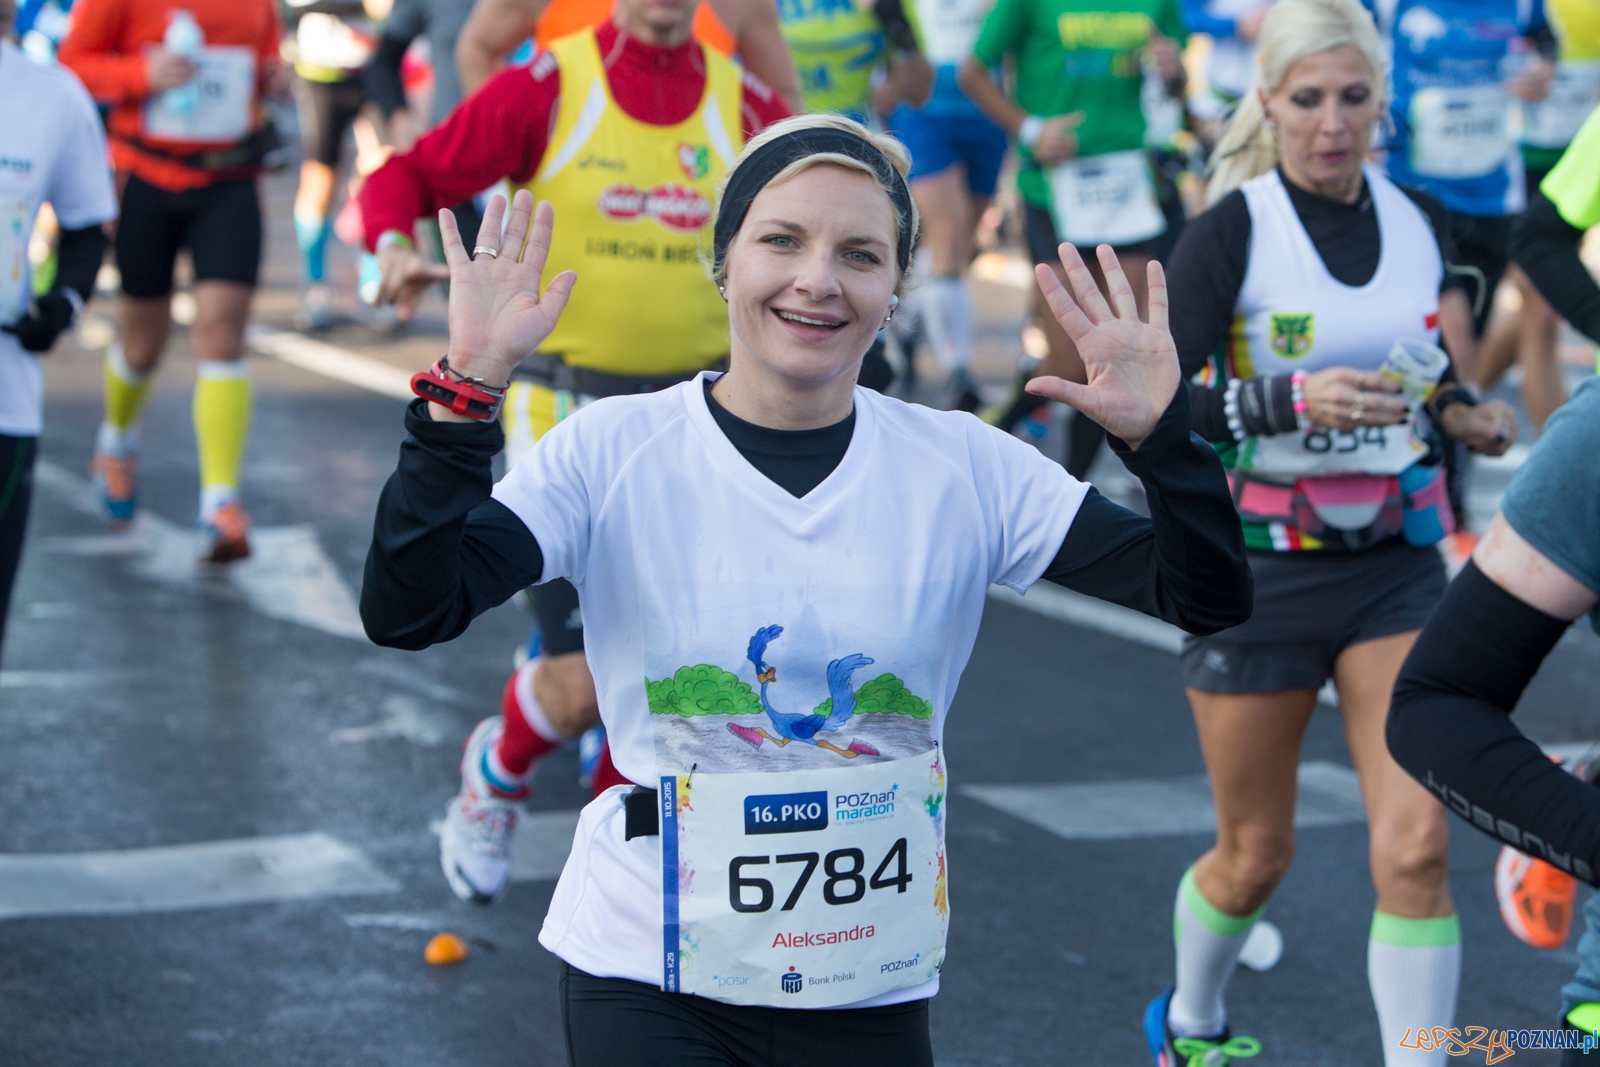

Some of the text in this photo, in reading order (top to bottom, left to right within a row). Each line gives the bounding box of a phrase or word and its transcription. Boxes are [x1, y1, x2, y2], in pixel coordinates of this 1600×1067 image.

[663, 781, 673, 818] 11.10.2015
[750, 803, 821, 823] 16. PKO
[835, 802, 895, 821] maraton
[728, 837, 913, 913] 6784
[771, 924, 875, 949] Aleksandra
[808, 975, 830, 986] Bank
[832, 971, 856, 983] Polski
